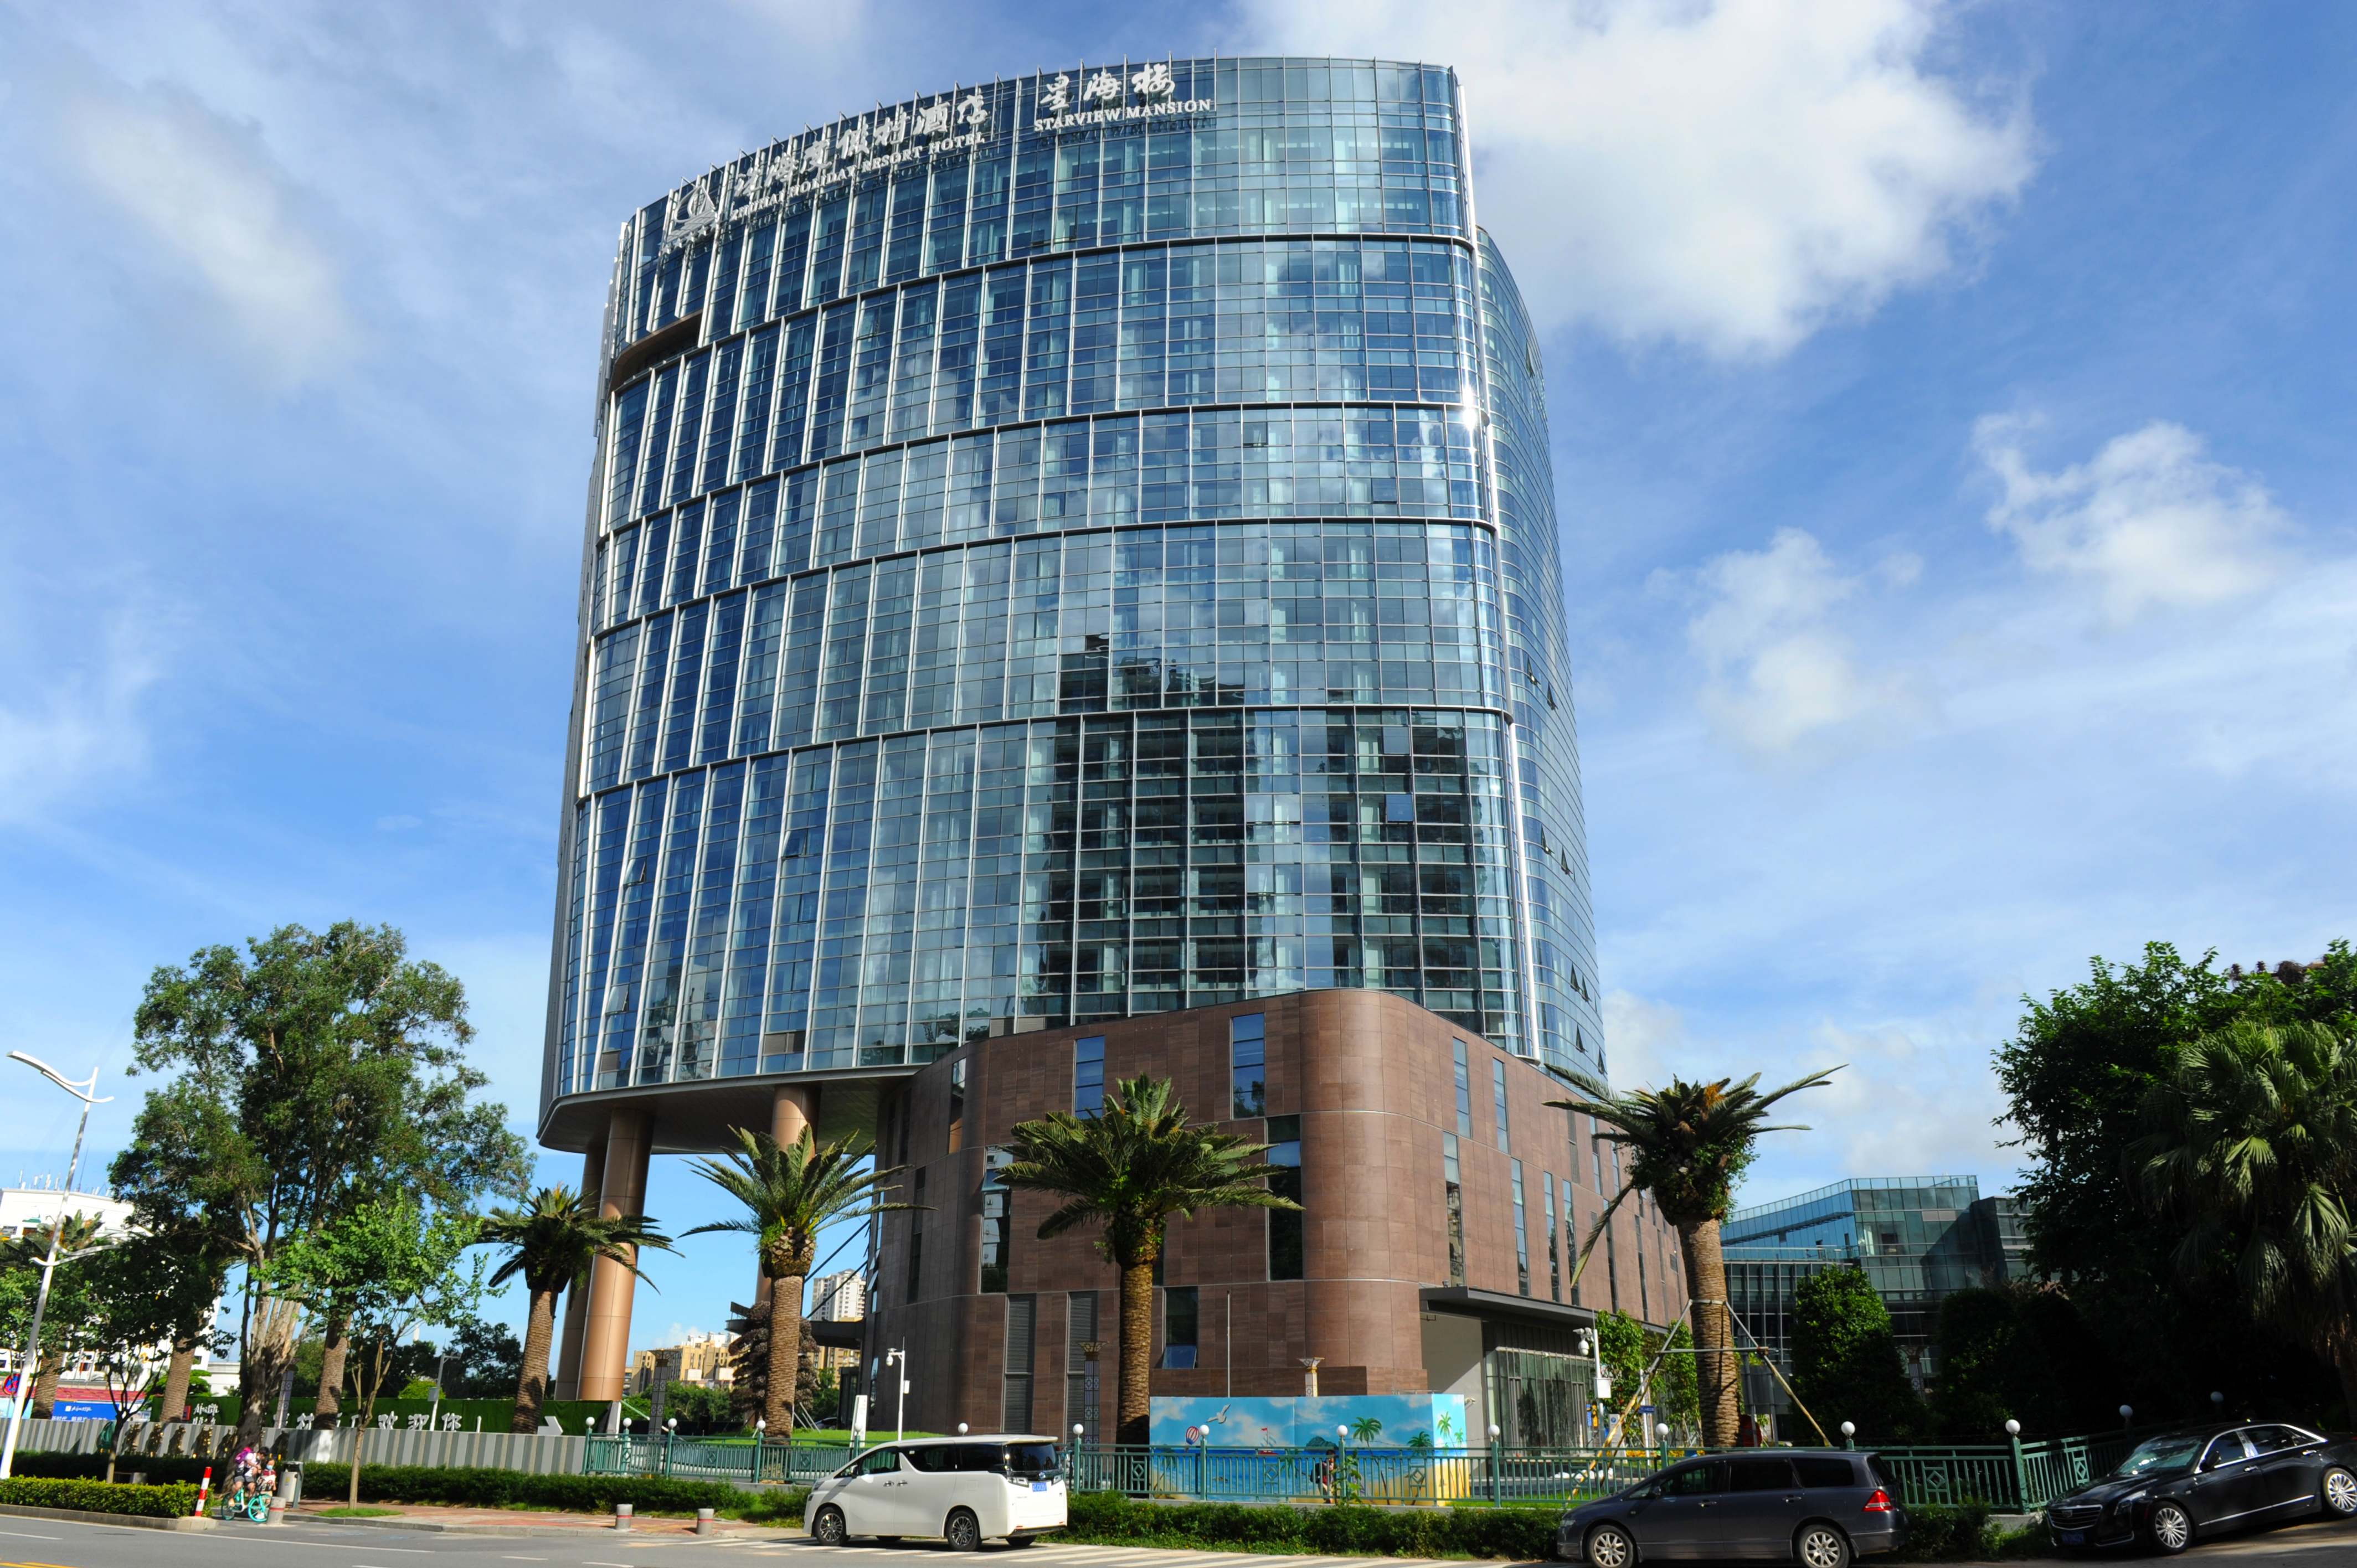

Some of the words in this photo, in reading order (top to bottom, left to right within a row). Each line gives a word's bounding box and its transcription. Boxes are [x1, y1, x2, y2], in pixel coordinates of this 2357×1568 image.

[1034, 107, 1121, 132] STARVIEW
[1126, 98, 1211, 119] MANSION
[729, 189, 785, 221] ZHUHAI
[787, 166, 857, 198] HOLIDAY
[861, 145, 923, 173] RESORT
[928, 131, 985, 154] HOTEL
